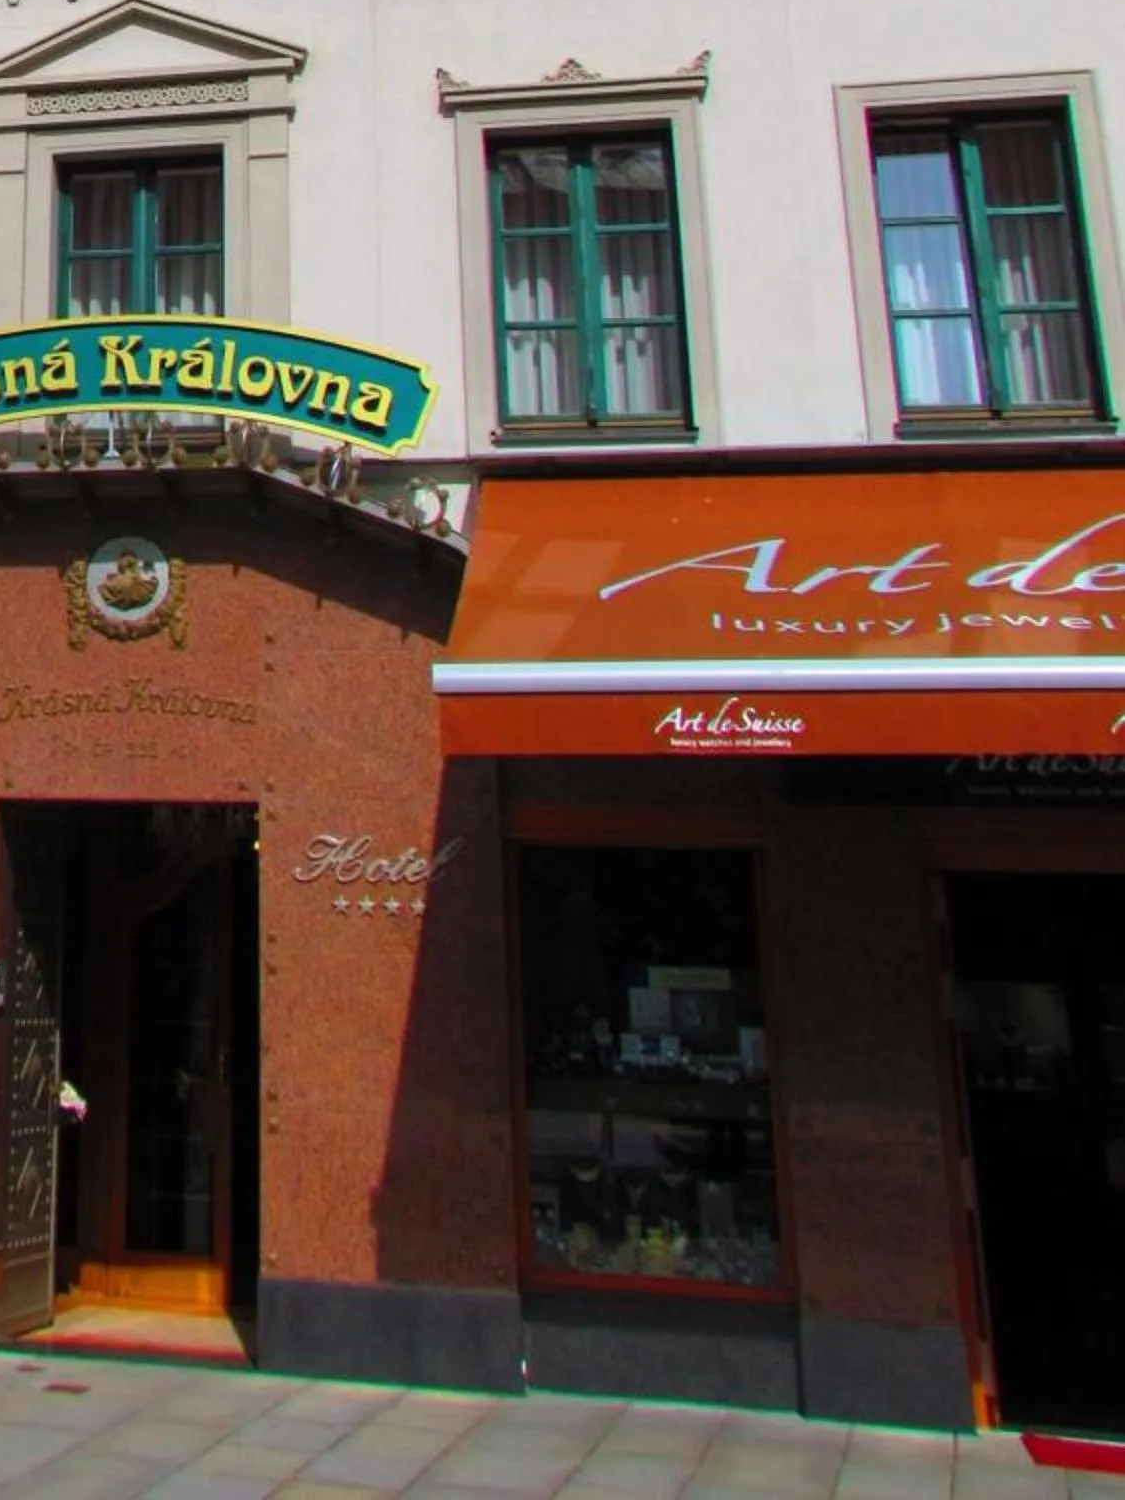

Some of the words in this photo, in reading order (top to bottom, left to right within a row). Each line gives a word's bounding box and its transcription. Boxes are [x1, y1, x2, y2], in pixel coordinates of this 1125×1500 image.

[97, 334, 395, 429] Královna
[600, 537, 950, 599] Art
[966, 512, 1125, 596] de
[712, 612, 916, 635] luxury
[113, 677, 258, 726] Královna
[654, 707, 707, 735] Art
[706, 696, 740, 735] de
[734, 706, 807, 734] Suisse
[291, 832, 467, 887] Hotel
